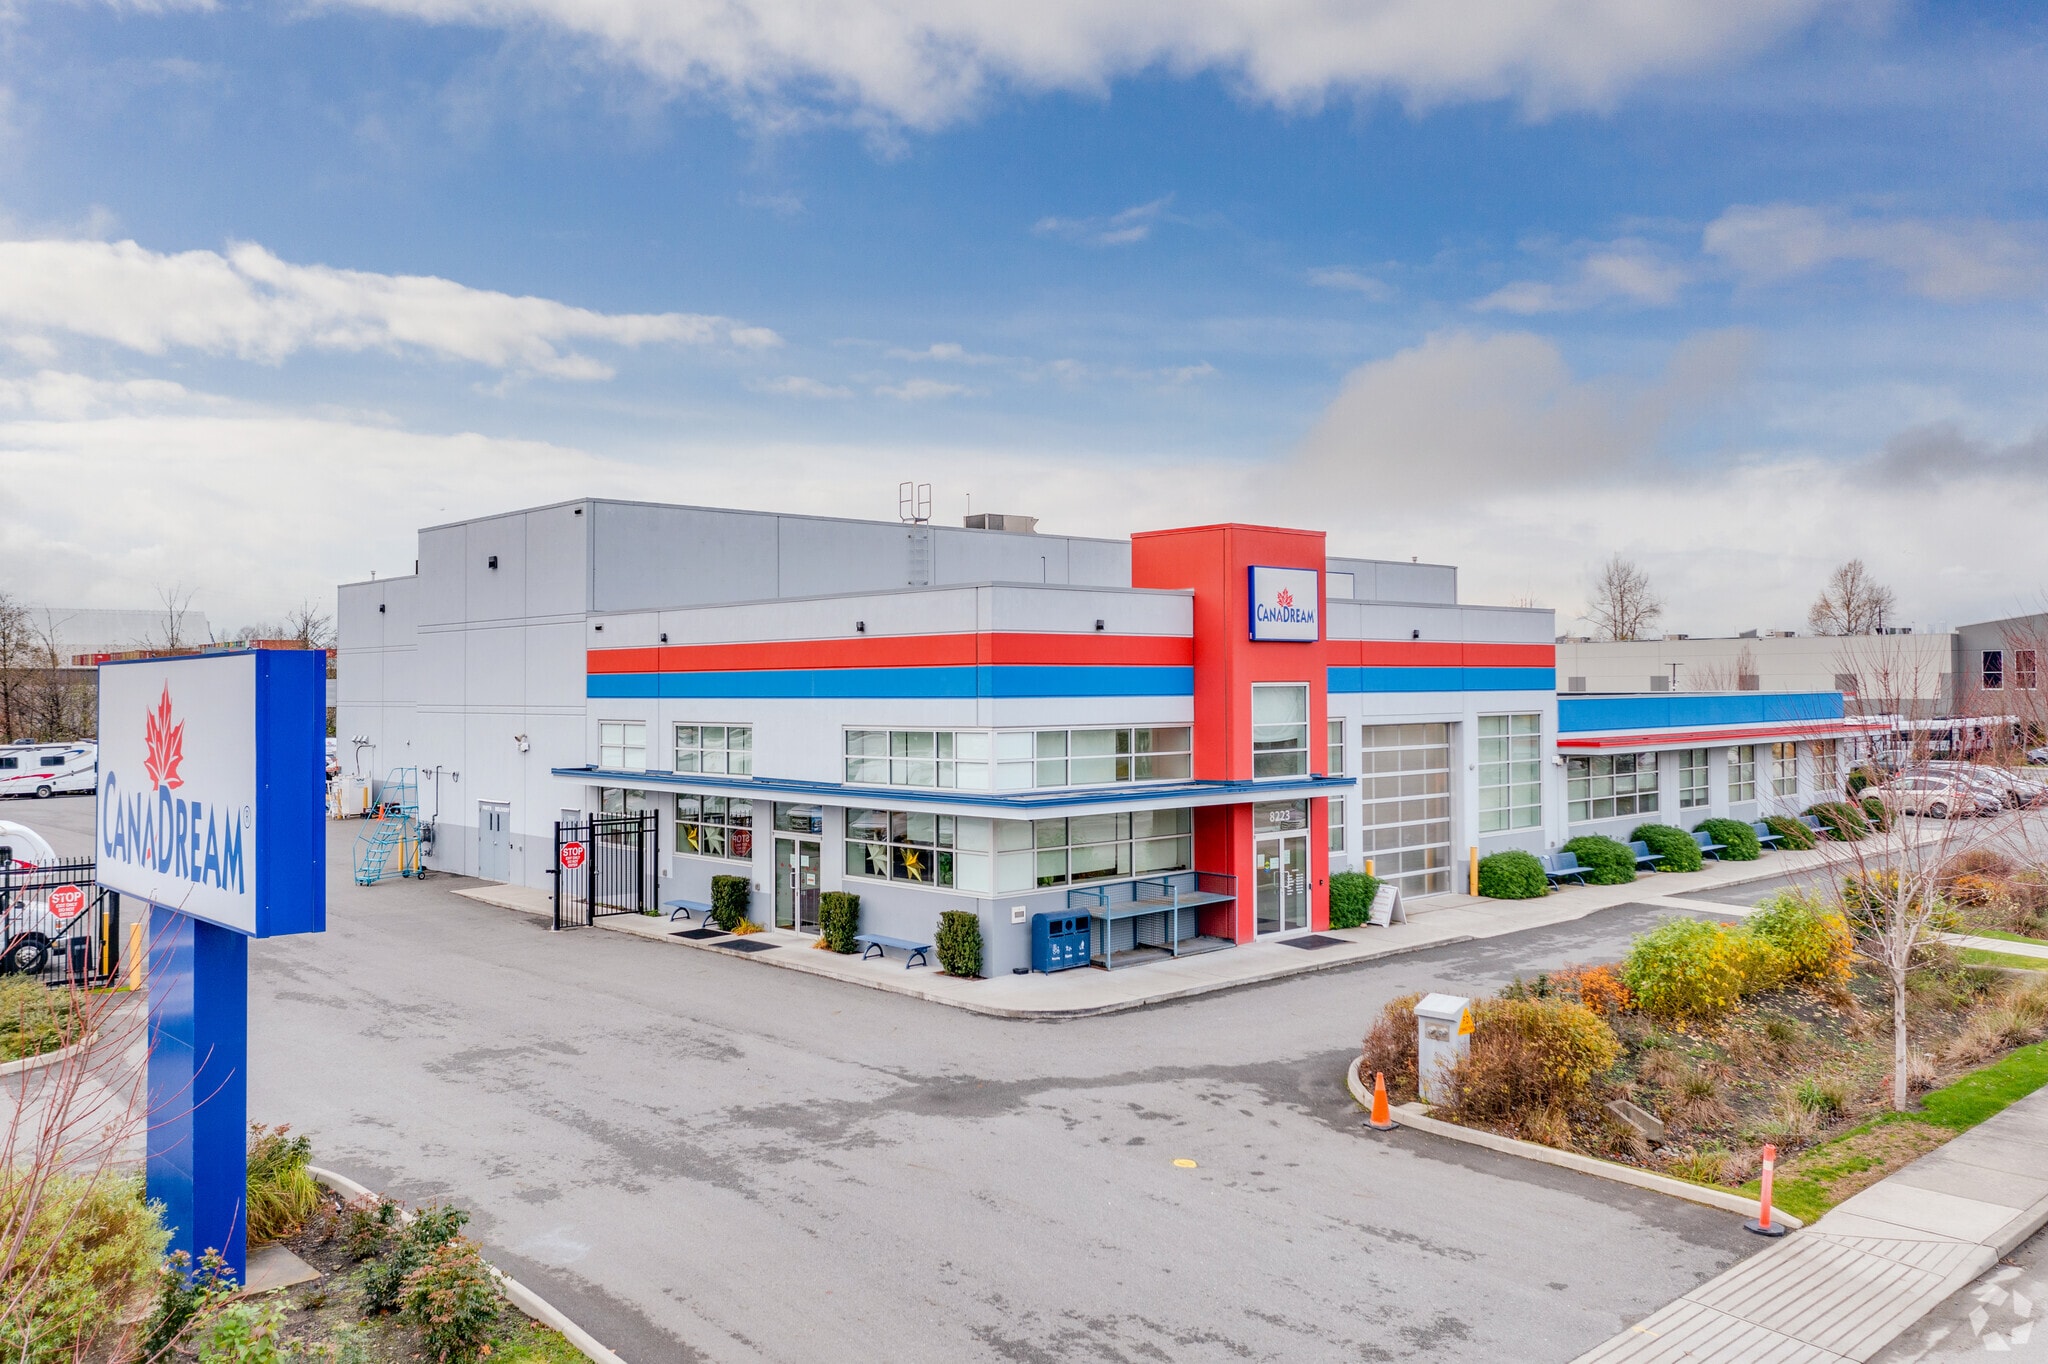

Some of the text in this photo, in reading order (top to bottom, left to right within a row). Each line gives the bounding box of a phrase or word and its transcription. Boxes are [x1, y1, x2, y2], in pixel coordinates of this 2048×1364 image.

[1270, 810, 1290, 822] 8223
[563, 847, 583, 856] STOP
[52, 892, 81, 904] STOP
